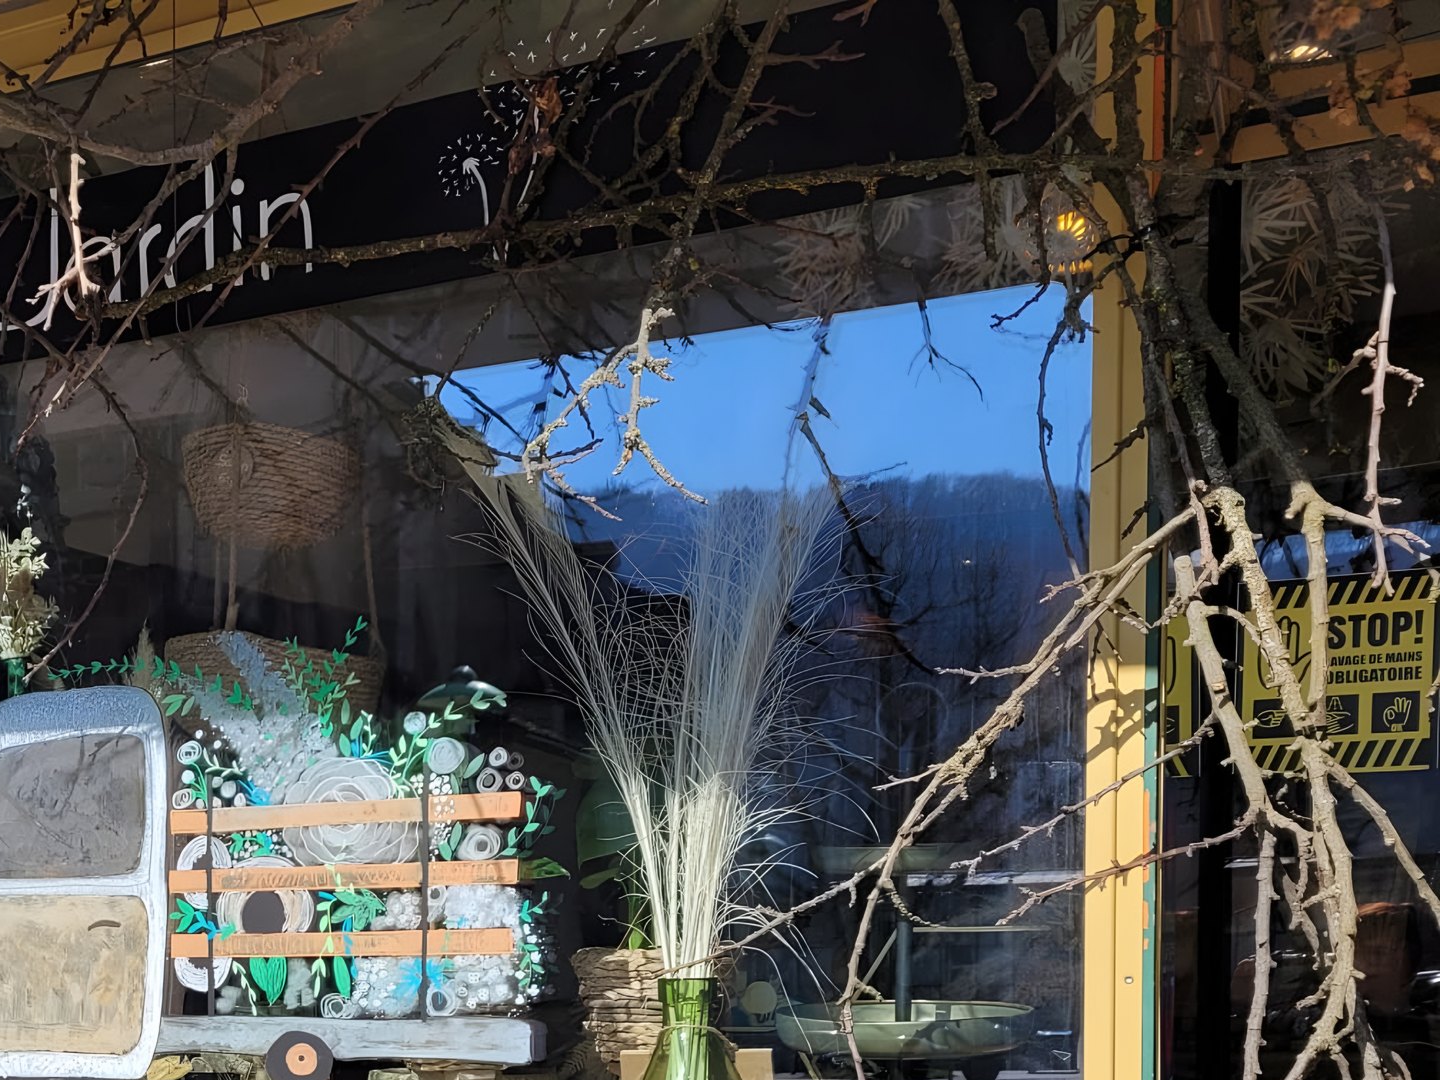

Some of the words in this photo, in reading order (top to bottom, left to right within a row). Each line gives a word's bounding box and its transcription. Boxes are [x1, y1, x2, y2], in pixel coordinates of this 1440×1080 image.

[1327, 610, 1424, 650] STOP!
[1329, 655, 1366, 667] AVAGE
[1369, 653, 1383, 665] DE
[1385, 651, 1423, 663] MAINS
